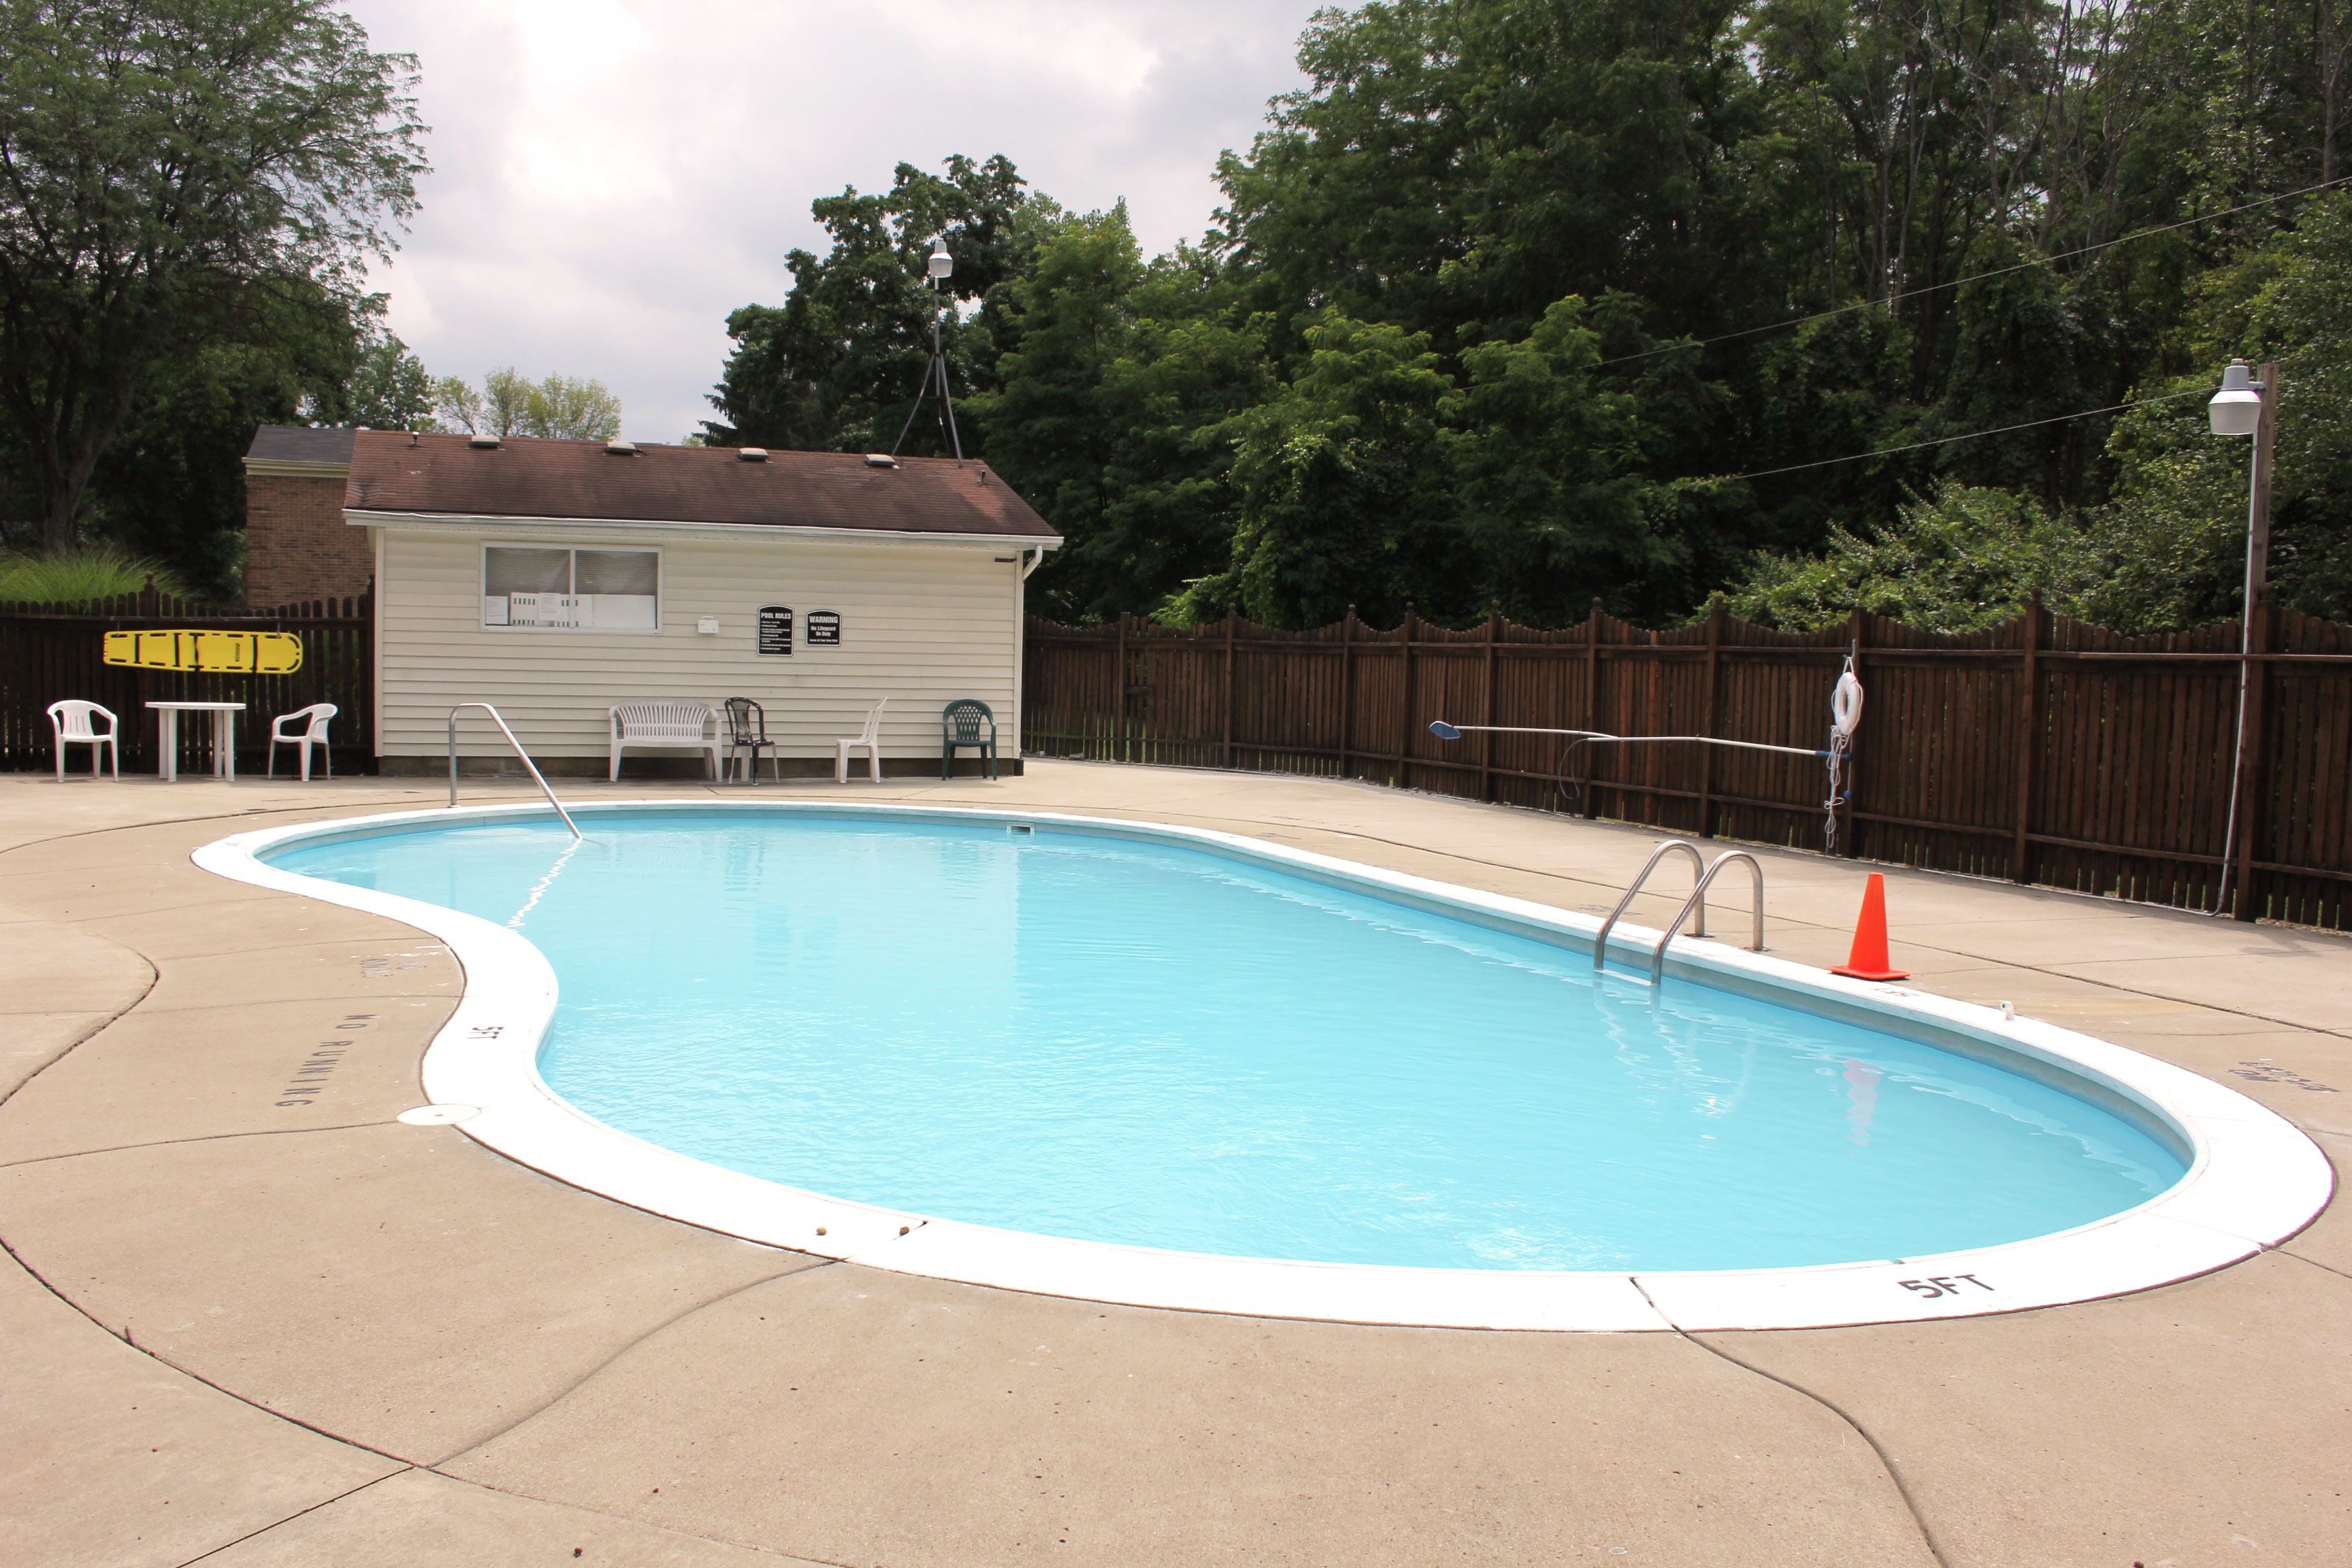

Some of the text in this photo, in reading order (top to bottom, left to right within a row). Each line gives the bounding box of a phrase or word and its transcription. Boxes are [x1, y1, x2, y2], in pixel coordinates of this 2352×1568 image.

[466, 1026, 504, 1040] 5FT
[274, 1014, 378, 1107] NO RUNNING
[1897, 1273, 1995, 1299] 5FT
